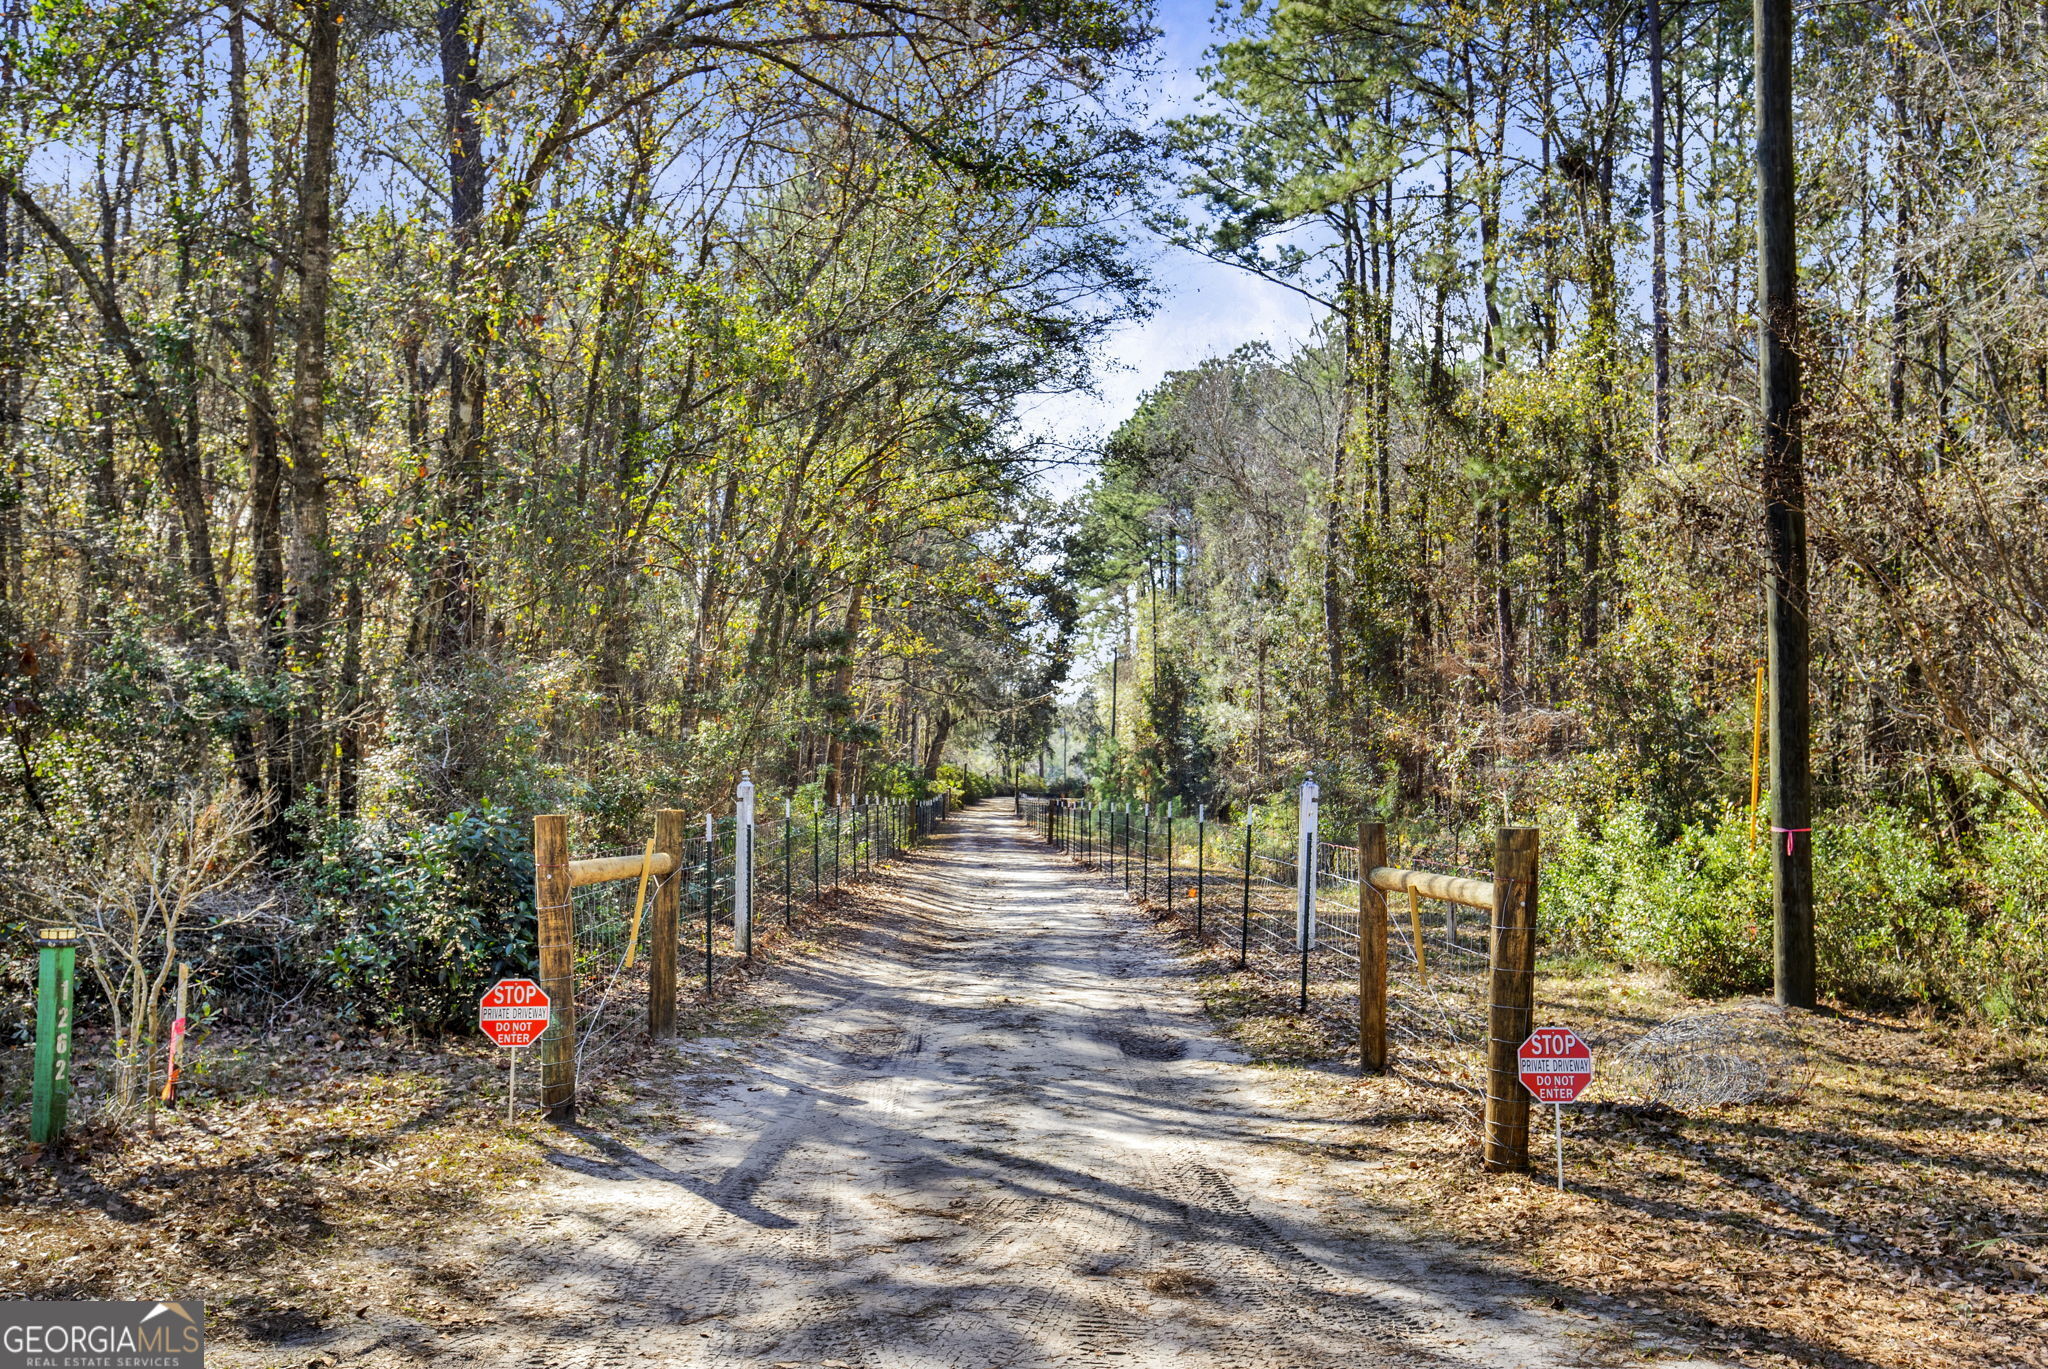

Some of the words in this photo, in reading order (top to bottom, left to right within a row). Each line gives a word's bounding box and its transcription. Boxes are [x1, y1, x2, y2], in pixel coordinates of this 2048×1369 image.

[494, 985, 537, 1004] STOP
[483, 1008, 510, 1019] PRIVATE
[512, 1008, 547, 1019] DRIVEWAY
[55, 980, 69, 1081] 1262
[496, 1022, 510, 1032] DO
[512, 1022, 533, 1032] NOT
[497, 1033, 530, 1043] ENTER
[1531, 1034, 1576, 1055] STOP
[1521, 1059, 1550, 1072] PRIVATE
[1552, 1059, 1589, 1072] DRIVEWAY
[1536, 1075, 1551, 1086] DO
[1554, 1075, 1575, 1086] NOT
[1539, 1088, 1573, 1099] ENTER
